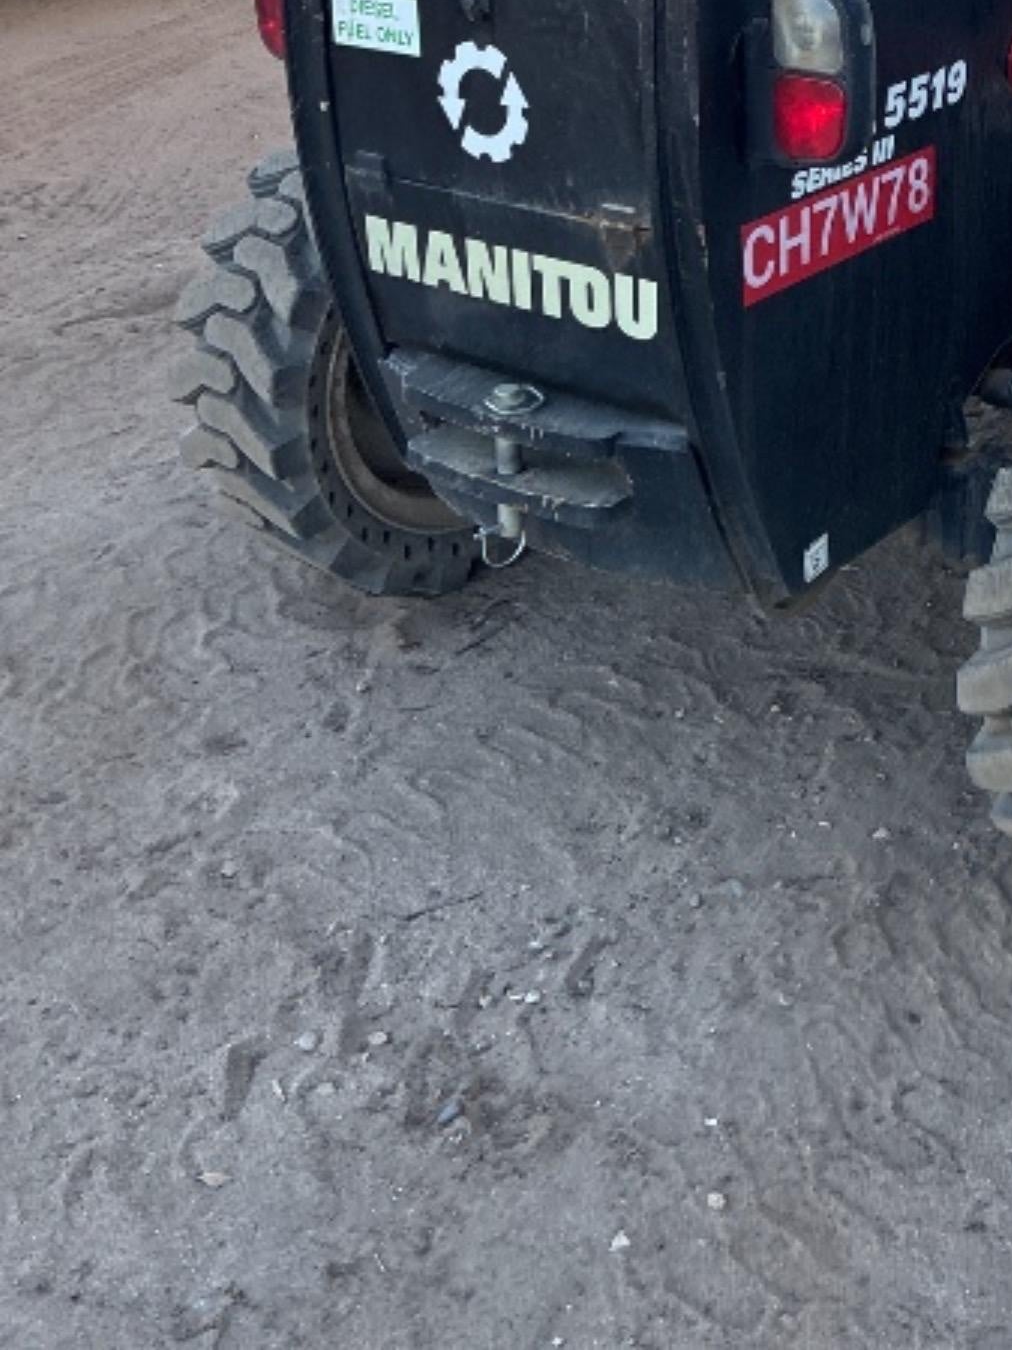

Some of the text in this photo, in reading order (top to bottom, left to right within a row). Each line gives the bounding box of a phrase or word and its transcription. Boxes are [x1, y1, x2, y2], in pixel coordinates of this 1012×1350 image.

[884, 60, 967, 127] 5519
[364, 212, 659, 341] MANITOU
[743, 158, 929, 289] CH7W78
